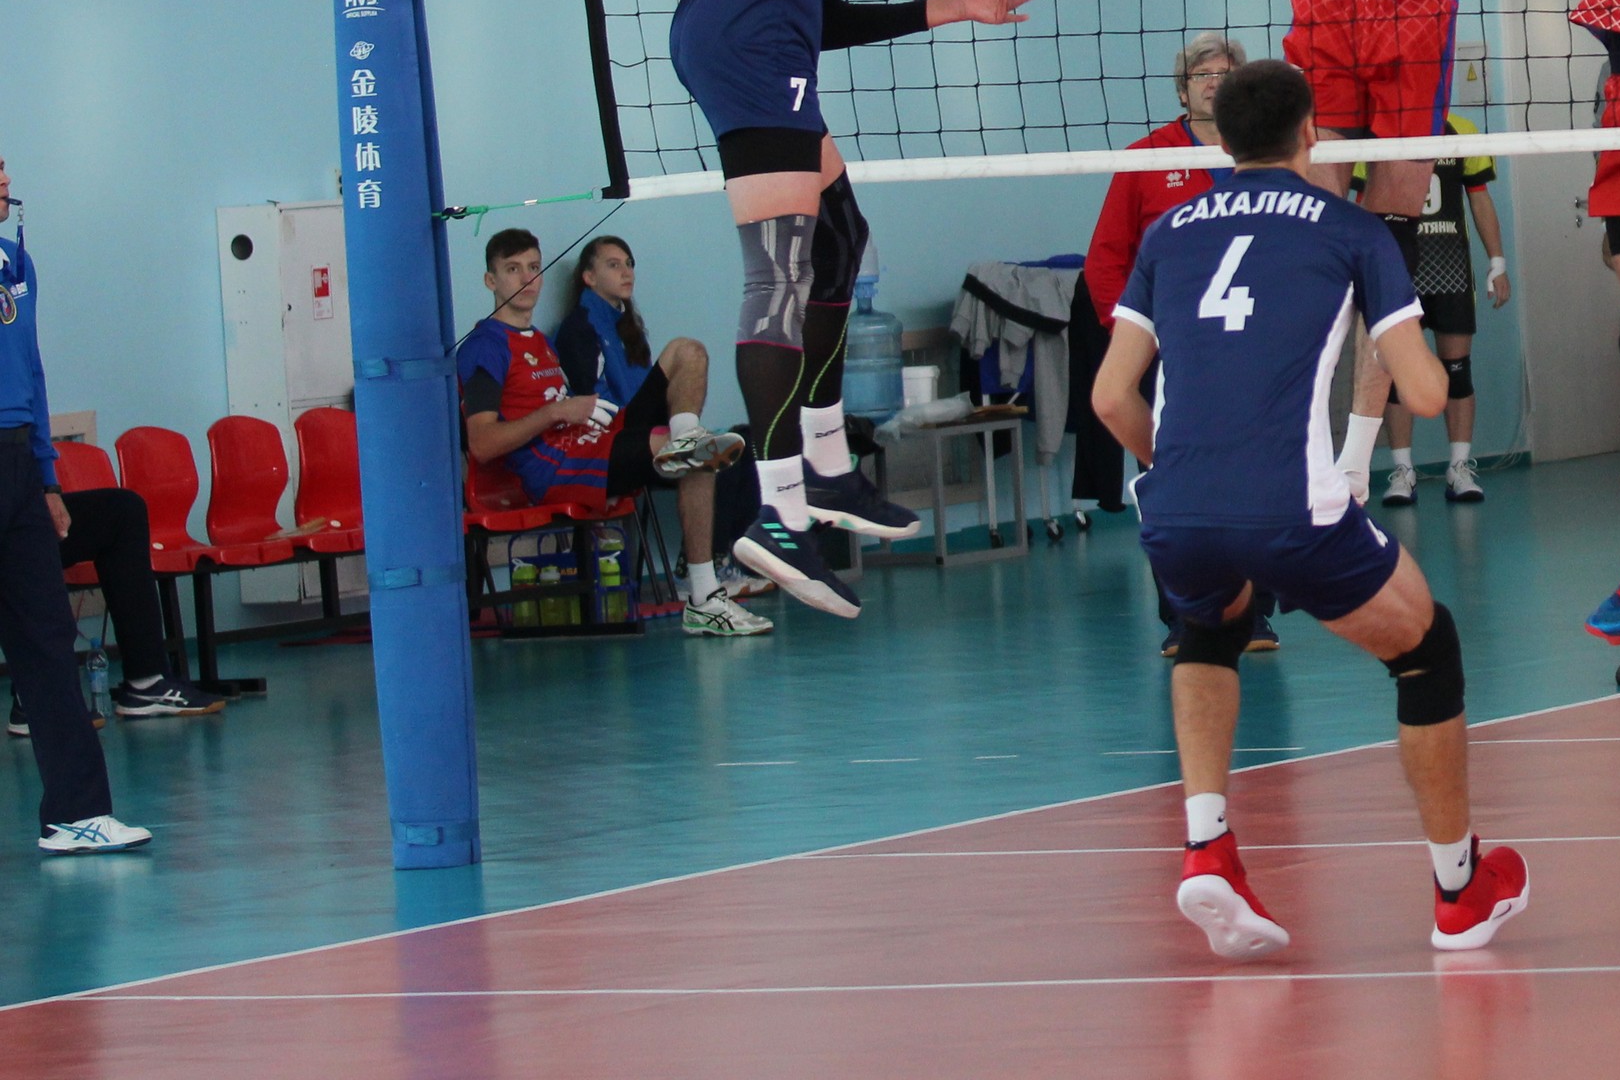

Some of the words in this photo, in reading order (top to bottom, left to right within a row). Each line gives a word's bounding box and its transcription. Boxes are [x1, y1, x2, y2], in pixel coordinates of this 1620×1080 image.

[790, 77, 807, 111] 7
[351, 69, 382, 209] 金陵体育
[1171, 191, 1327, 228] САХАЛИН
[1198, 235, 1255, 331] 4
